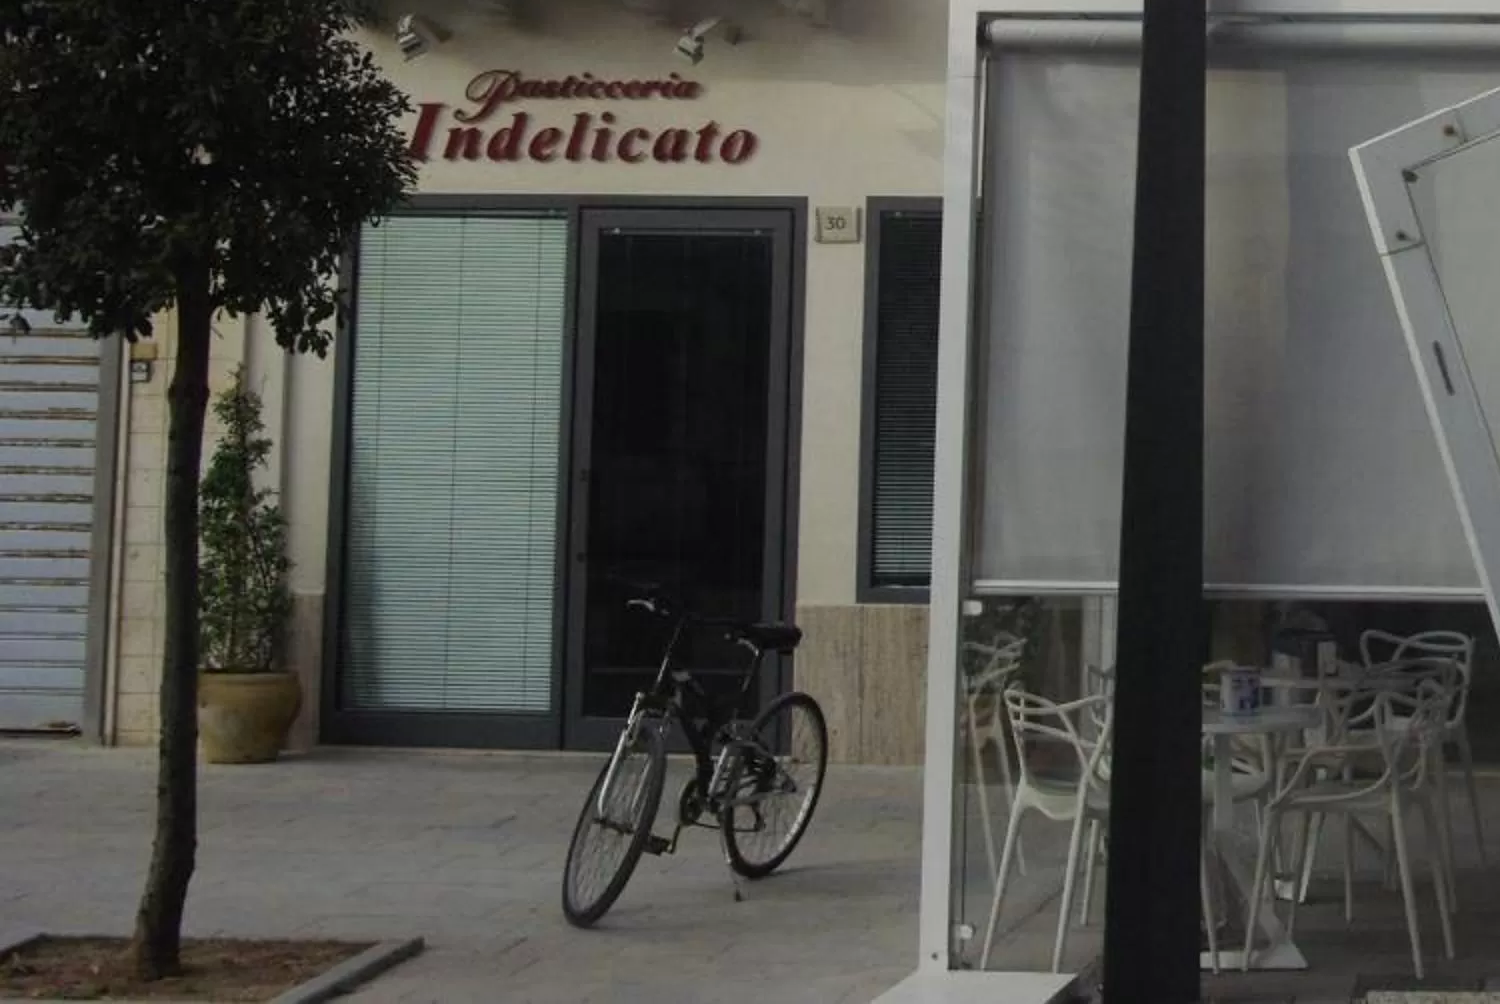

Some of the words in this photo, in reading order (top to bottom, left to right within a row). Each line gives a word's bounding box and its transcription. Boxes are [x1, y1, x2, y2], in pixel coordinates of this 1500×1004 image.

[453, 69, 704, 123] Pasticceria
[407, 102, 760, 164] Indelicato
[824, 215, 847, 231] 30
